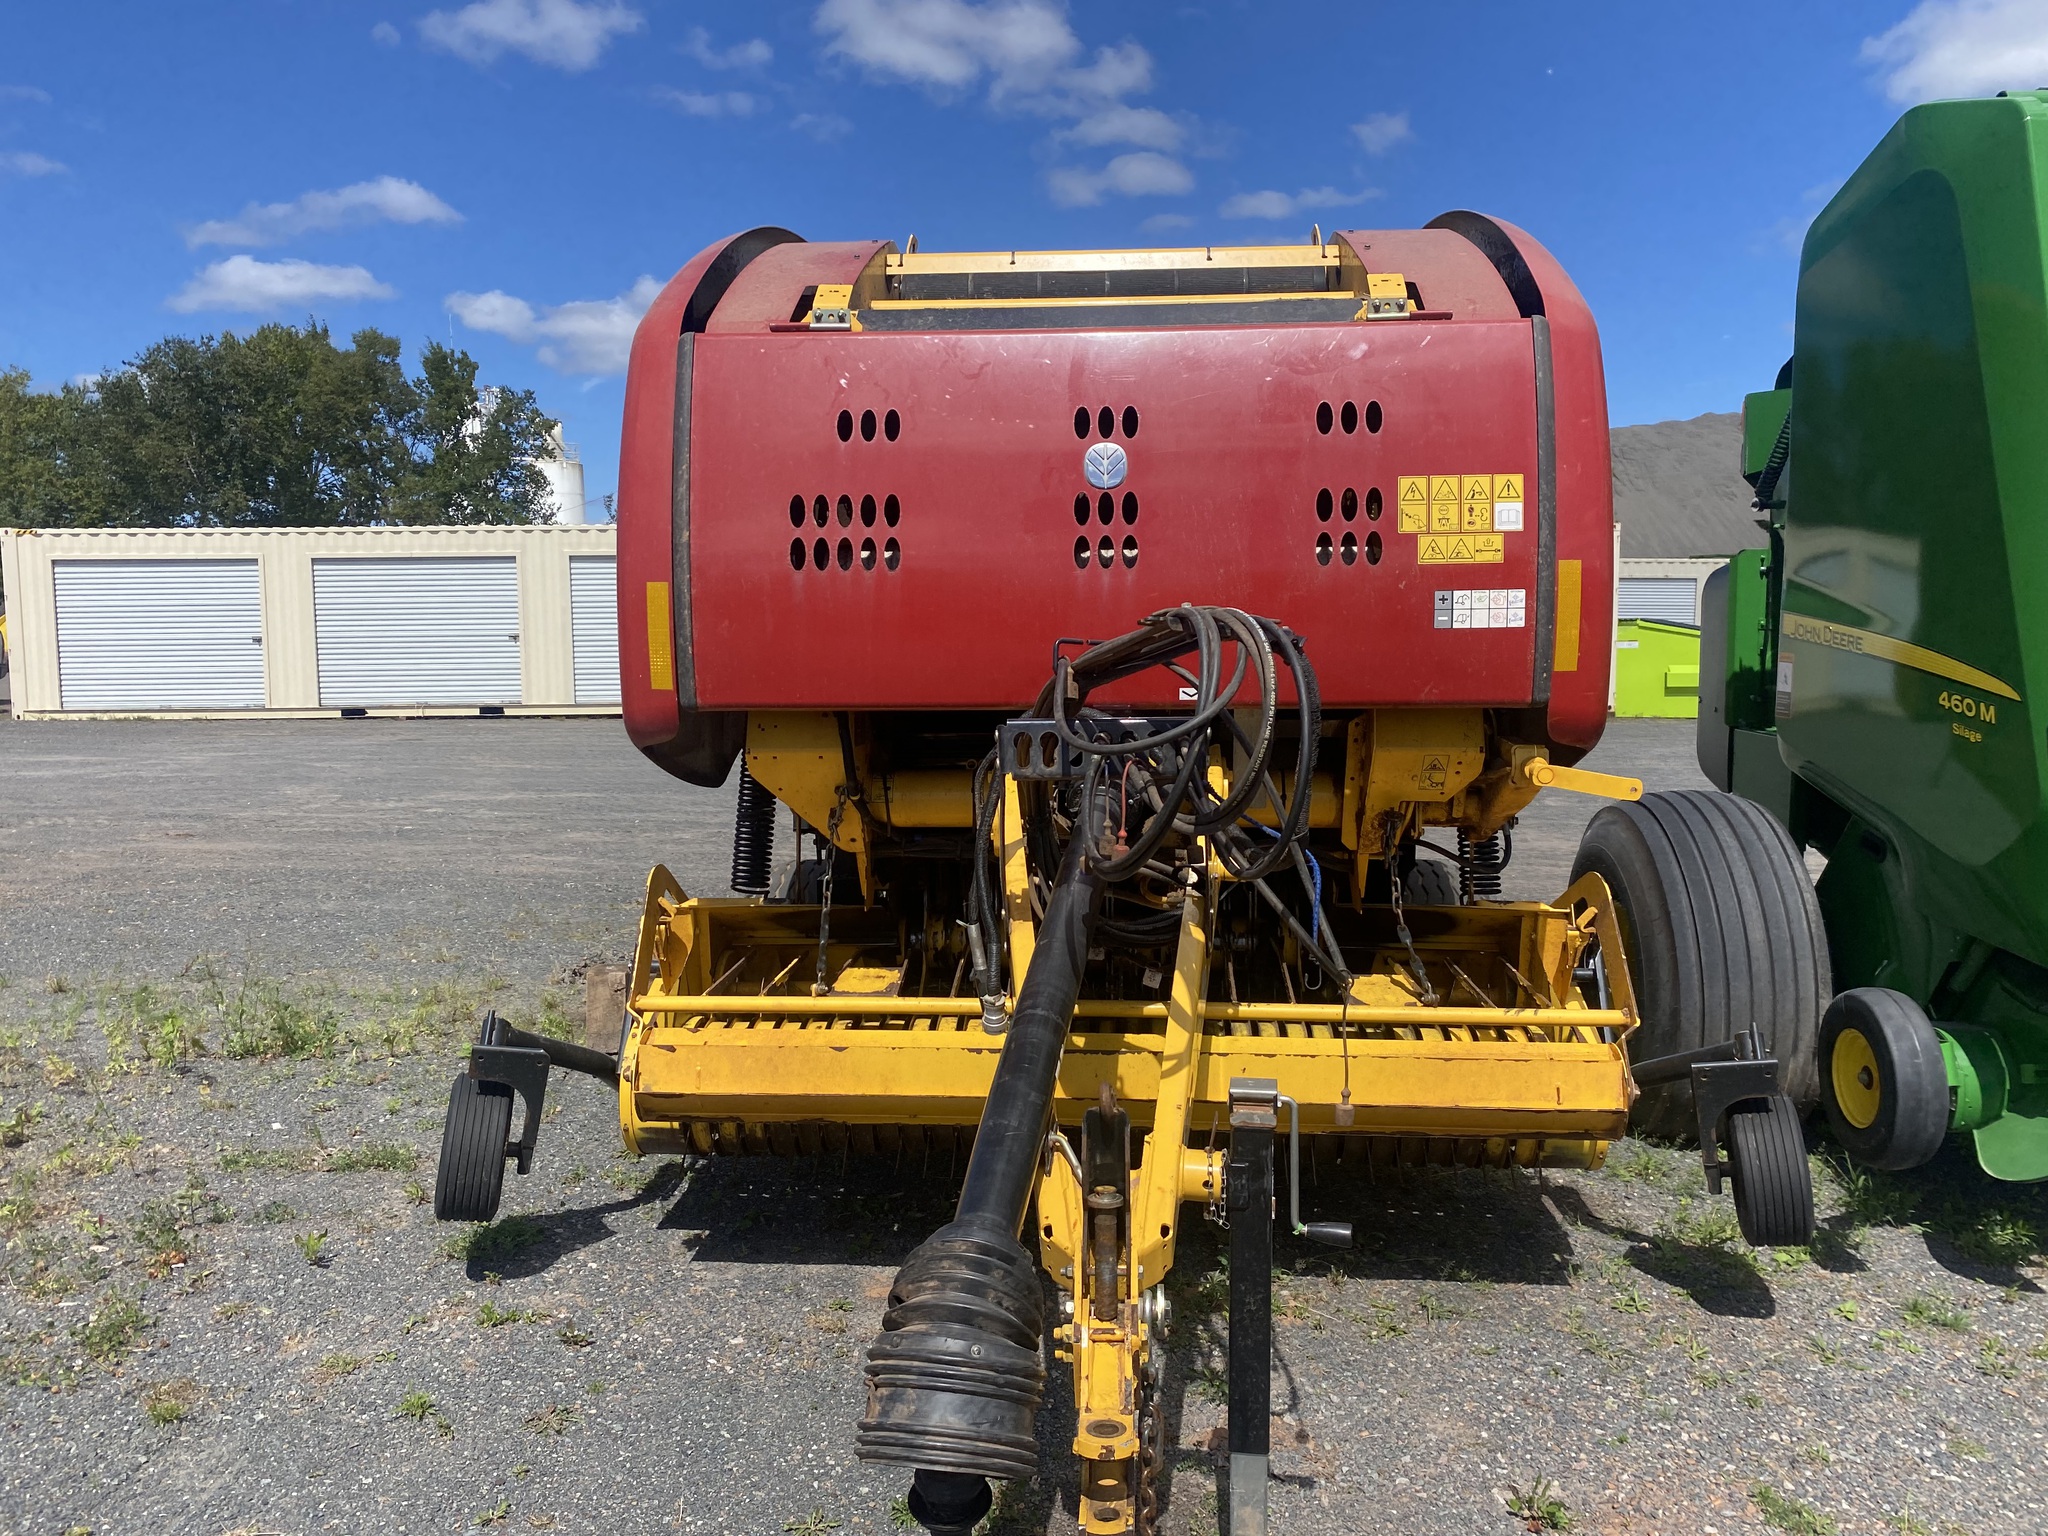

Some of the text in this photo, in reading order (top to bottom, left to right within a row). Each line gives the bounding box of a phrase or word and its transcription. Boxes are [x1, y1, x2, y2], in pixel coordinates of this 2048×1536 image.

[1790, 619, 1864, 652] JOHN DEERE
[1938, 691, 1996, 724] 460 M
[1264, 717, 1273, 739] FLAME
[1952, 722, 1982, 743] Silage
[1253, 740, 1268, 771] RESISTANT
